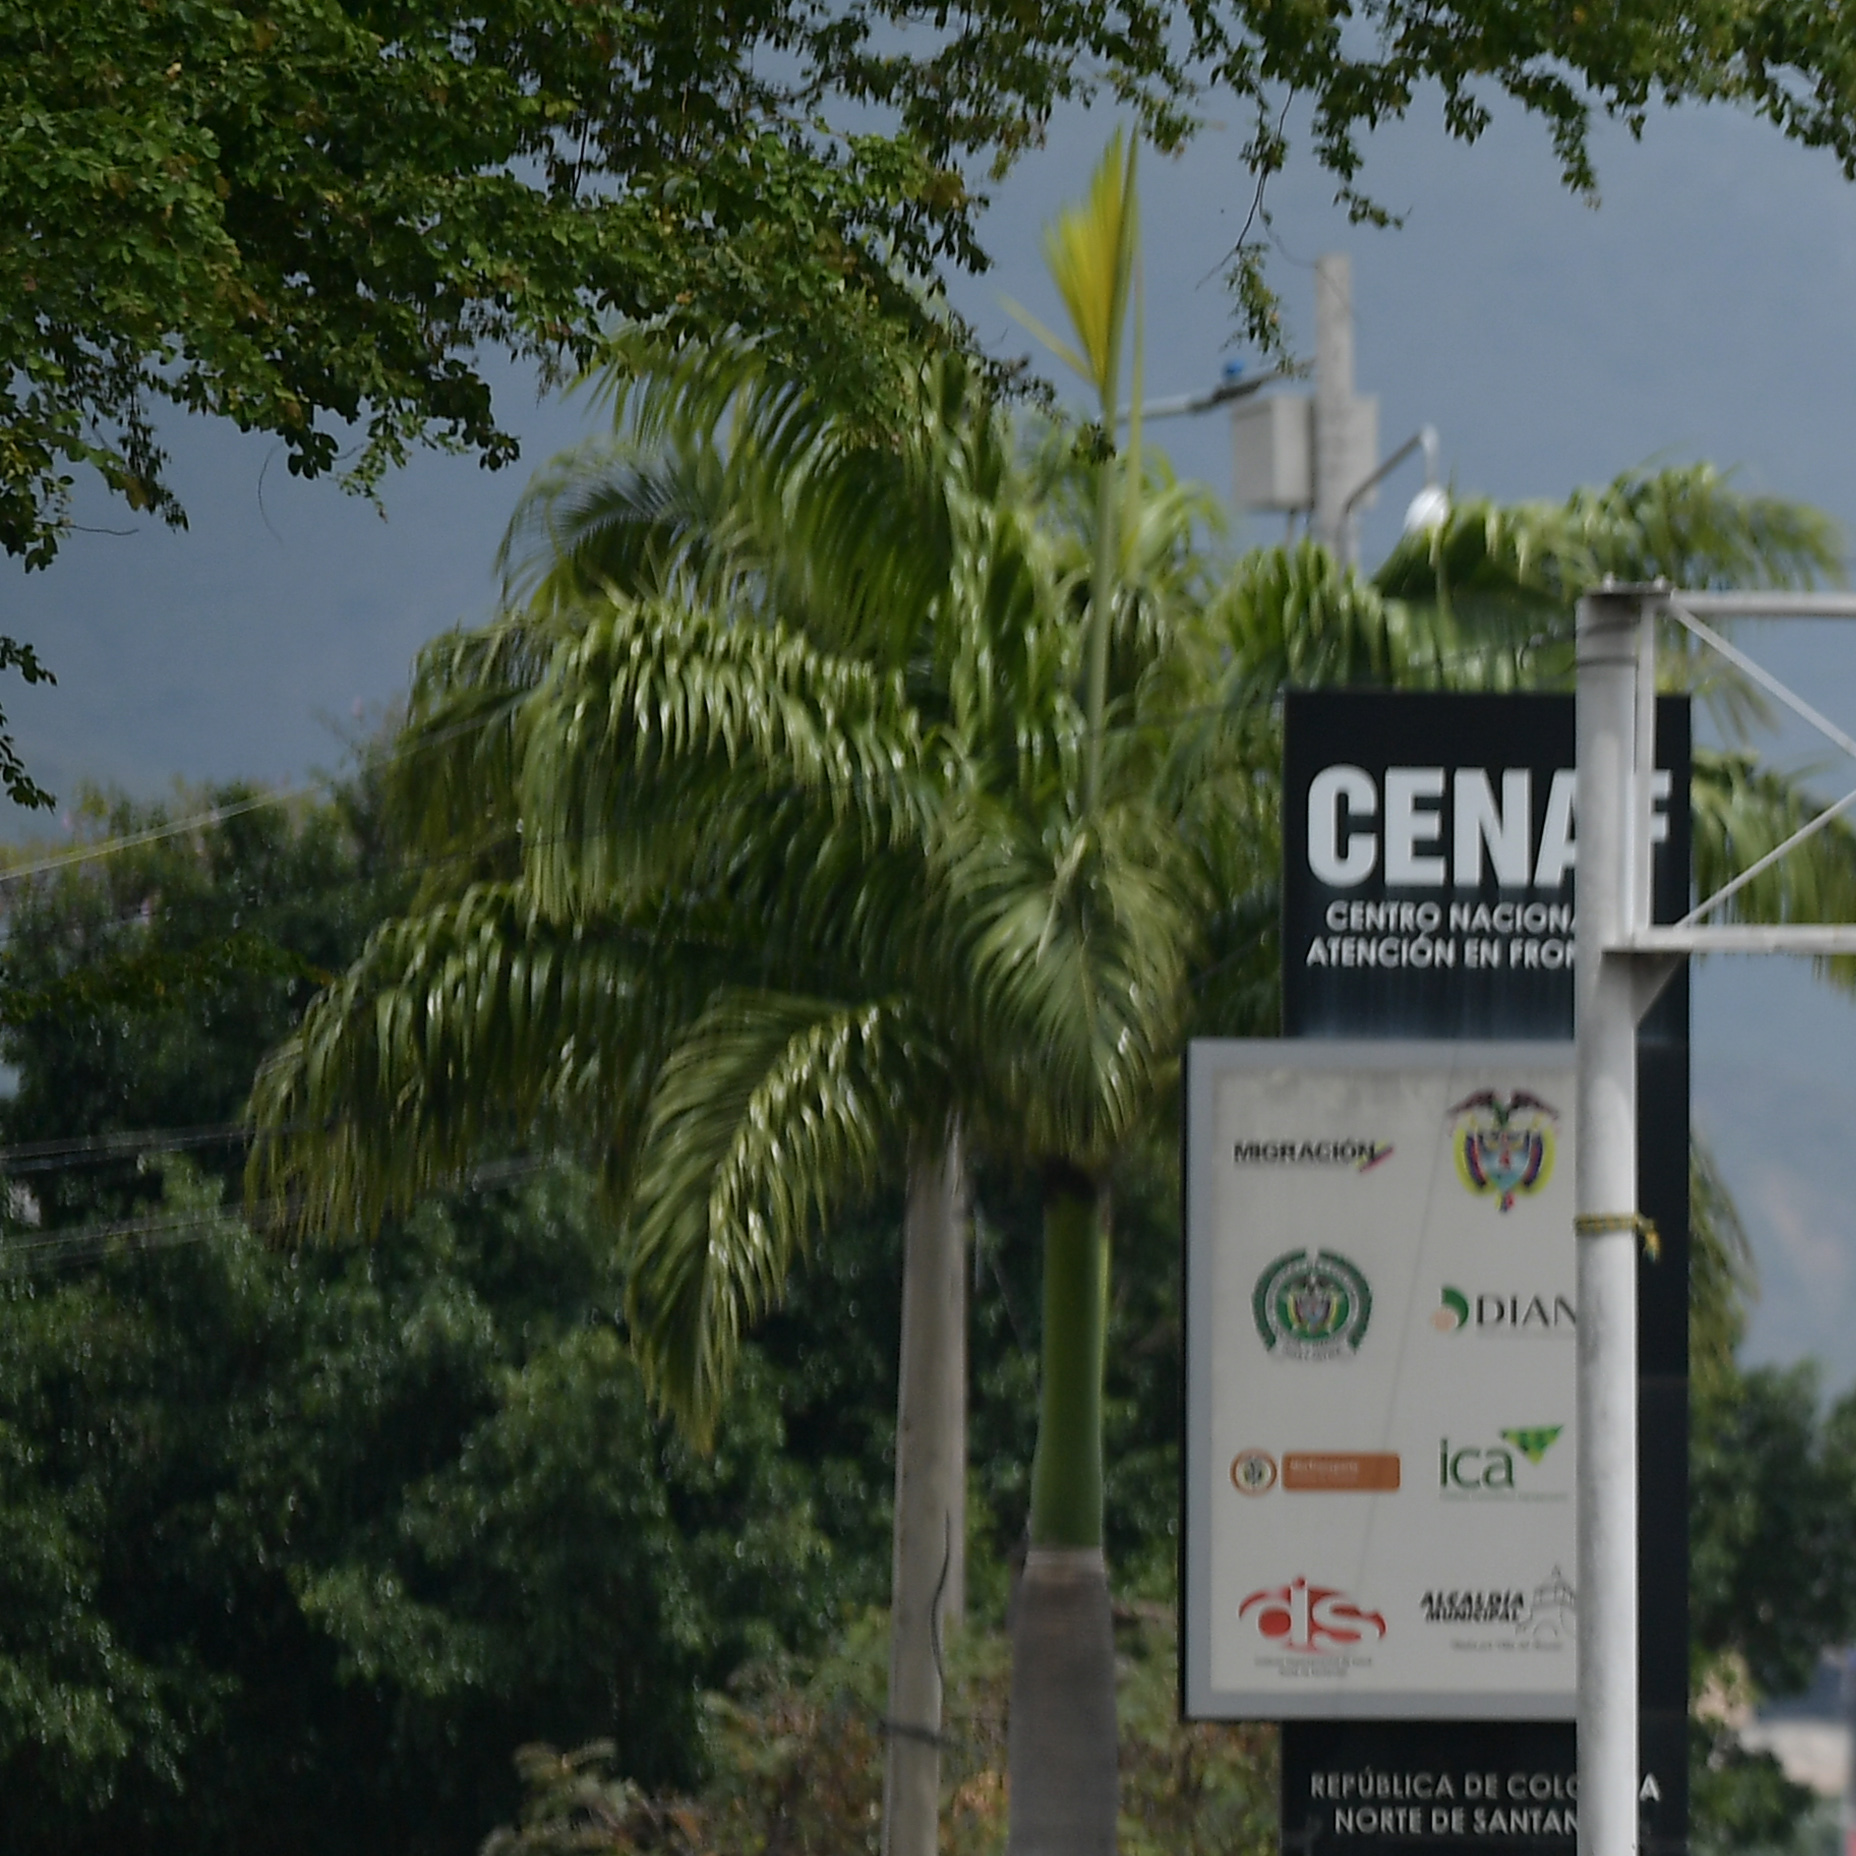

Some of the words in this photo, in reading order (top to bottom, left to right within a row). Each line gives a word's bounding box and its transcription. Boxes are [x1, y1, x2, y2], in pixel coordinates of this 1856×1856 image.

[1326, 901, 1442, 933] CENTRO
[1449, 901, 1576, 934] NACION
[1305, 931, 1457, 968] ATENCIÓN
[1464, 936, 1499, 968] EN
[1234, 1137, 1377, 1163] MIGRACIÓN
[1476, 1293, 1577, 1327] DIAN
[1439, 1437, 1515, 1489] ica
[1310, 1765, 1454, 1800] REPÚBLICA
[1464, 1773, 1498, 1800] DE
[1506, 1773, 1661, 1802] COLOA
[1335, 1807, 1423, 1835] NORTE
[1431, 1807, 1465, 1835] DE
[1473, 1807, 1578, 1835] SANTAN
